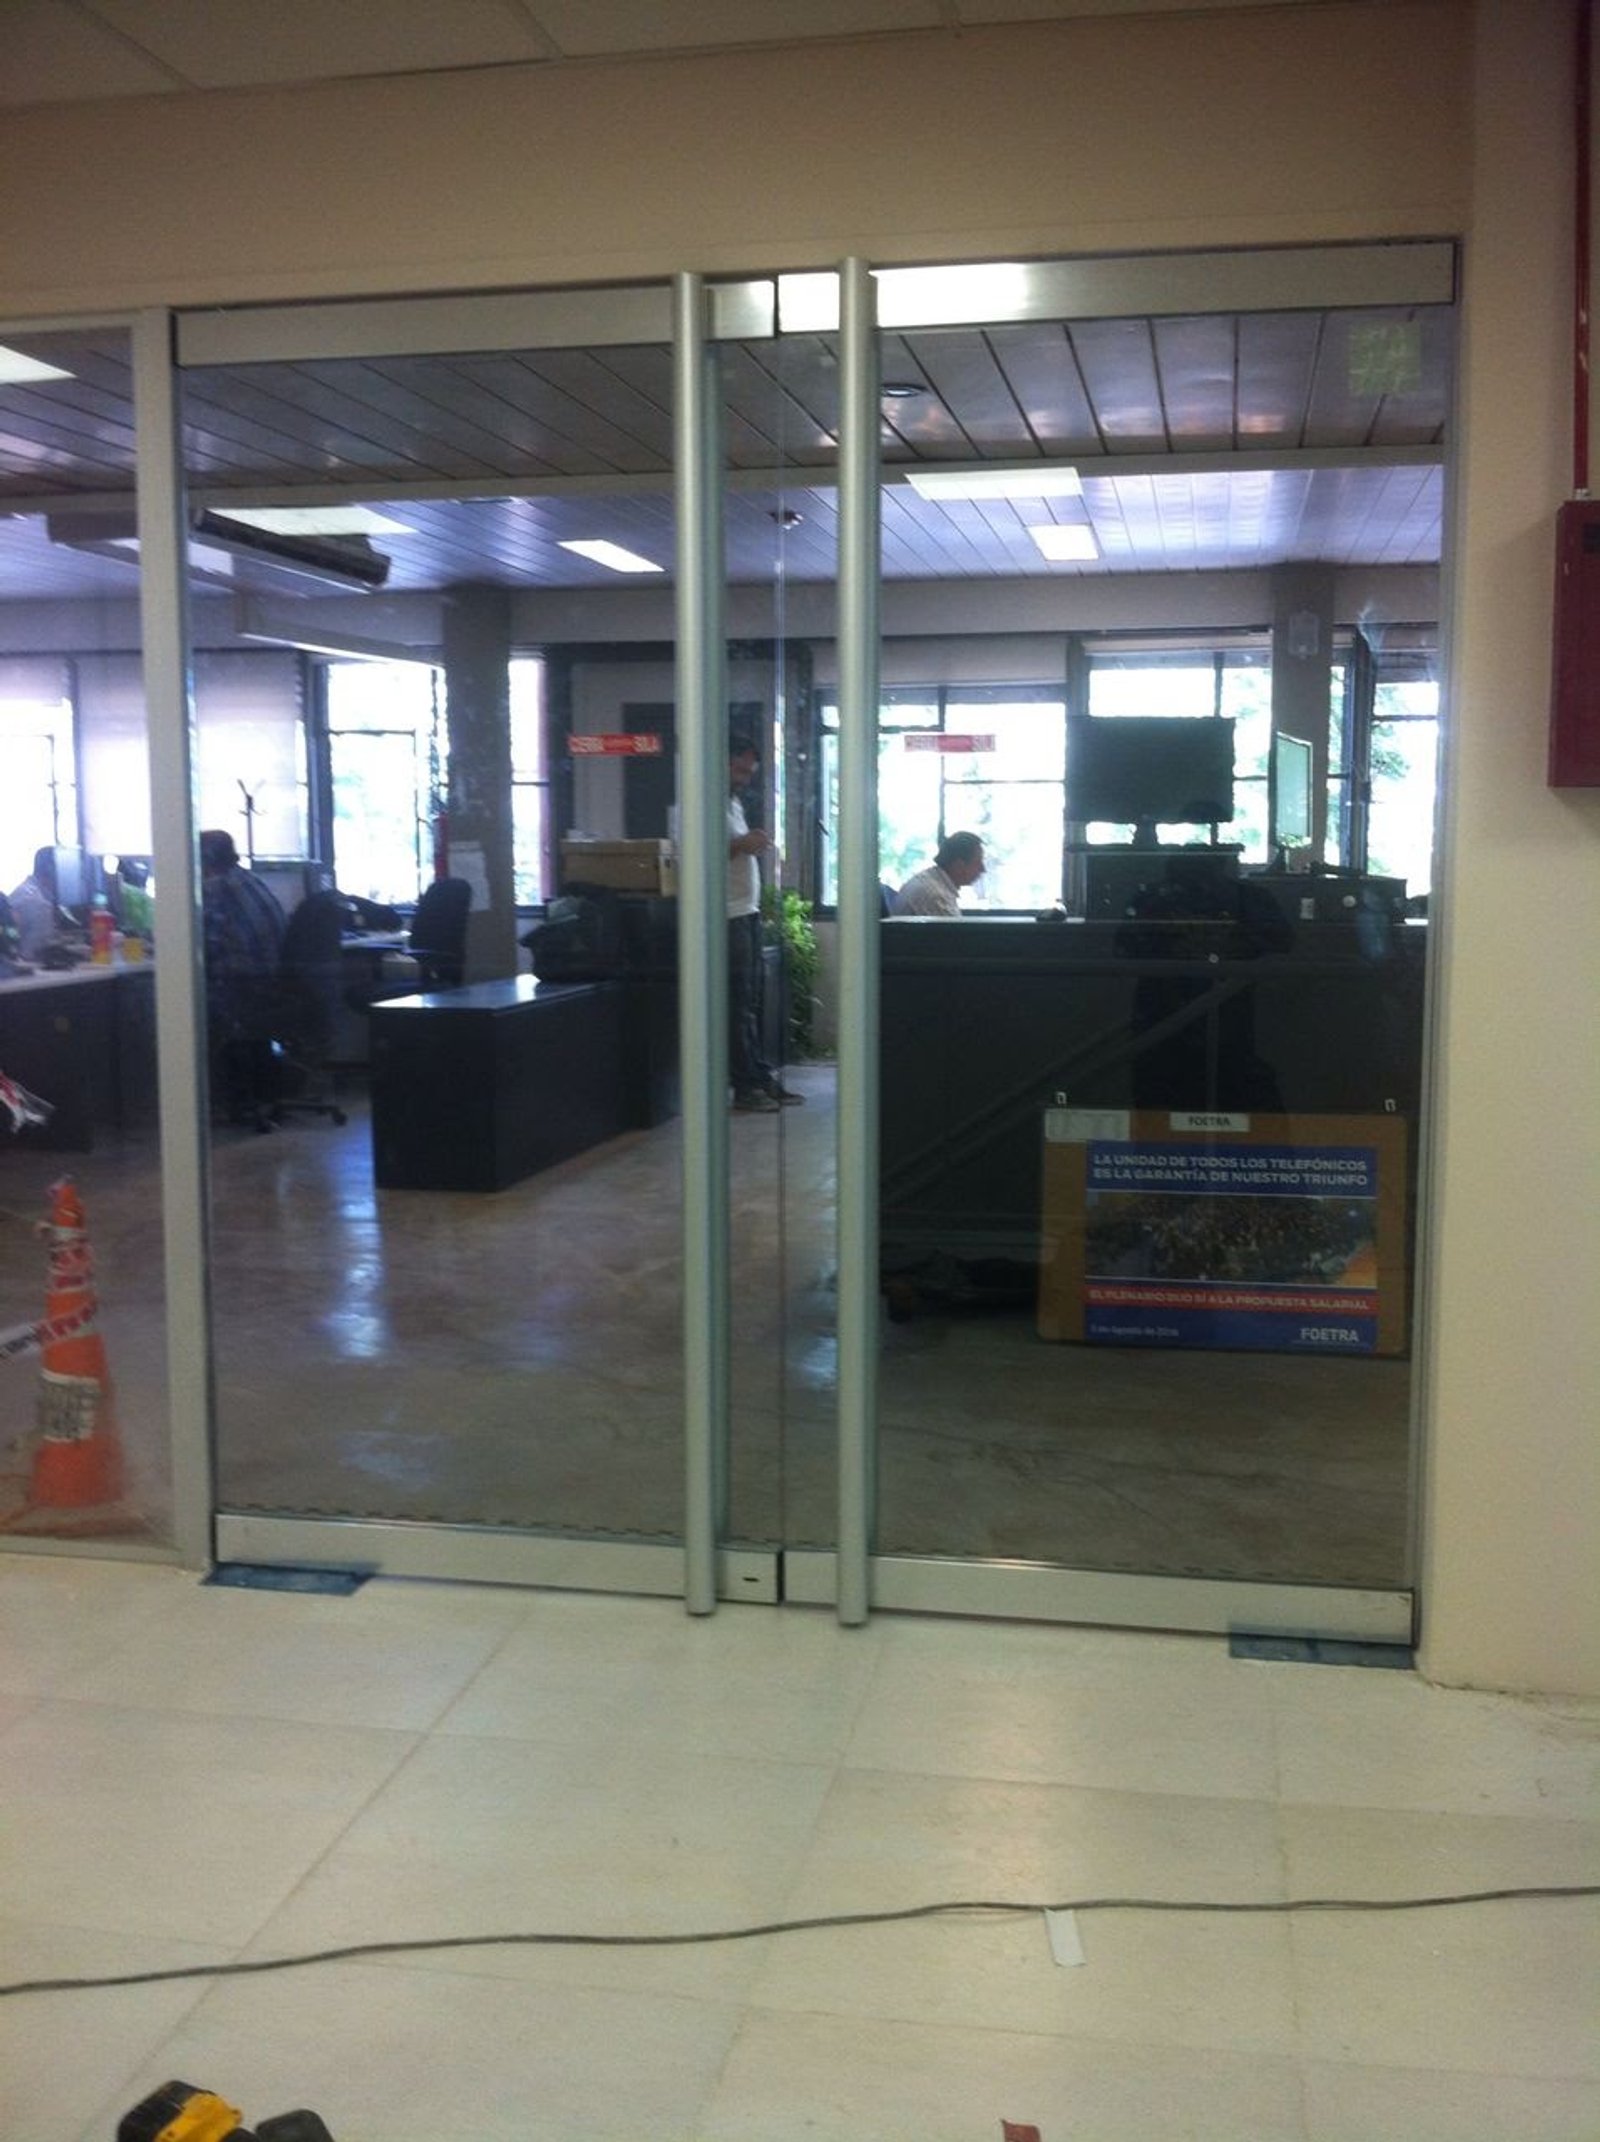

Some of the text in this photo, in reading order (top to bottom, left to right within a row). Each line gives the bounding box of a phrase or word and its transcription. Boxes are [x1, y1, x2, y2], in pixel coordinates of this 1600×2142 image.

[1094, 1154, 1367, 1171] LA UNIDAD DE TODOS LOS TELEFÓNICOS
[1094, 1167, 1368, 1186] ES LA GARANTÍA DE NUESTRO TRIUNFO
[1218, 1295, 1233, 1304] LA
[1235, 1296, 1307, 1307] PROPUESTA
[1300, 1327, 1360, 1342] FOETRA
